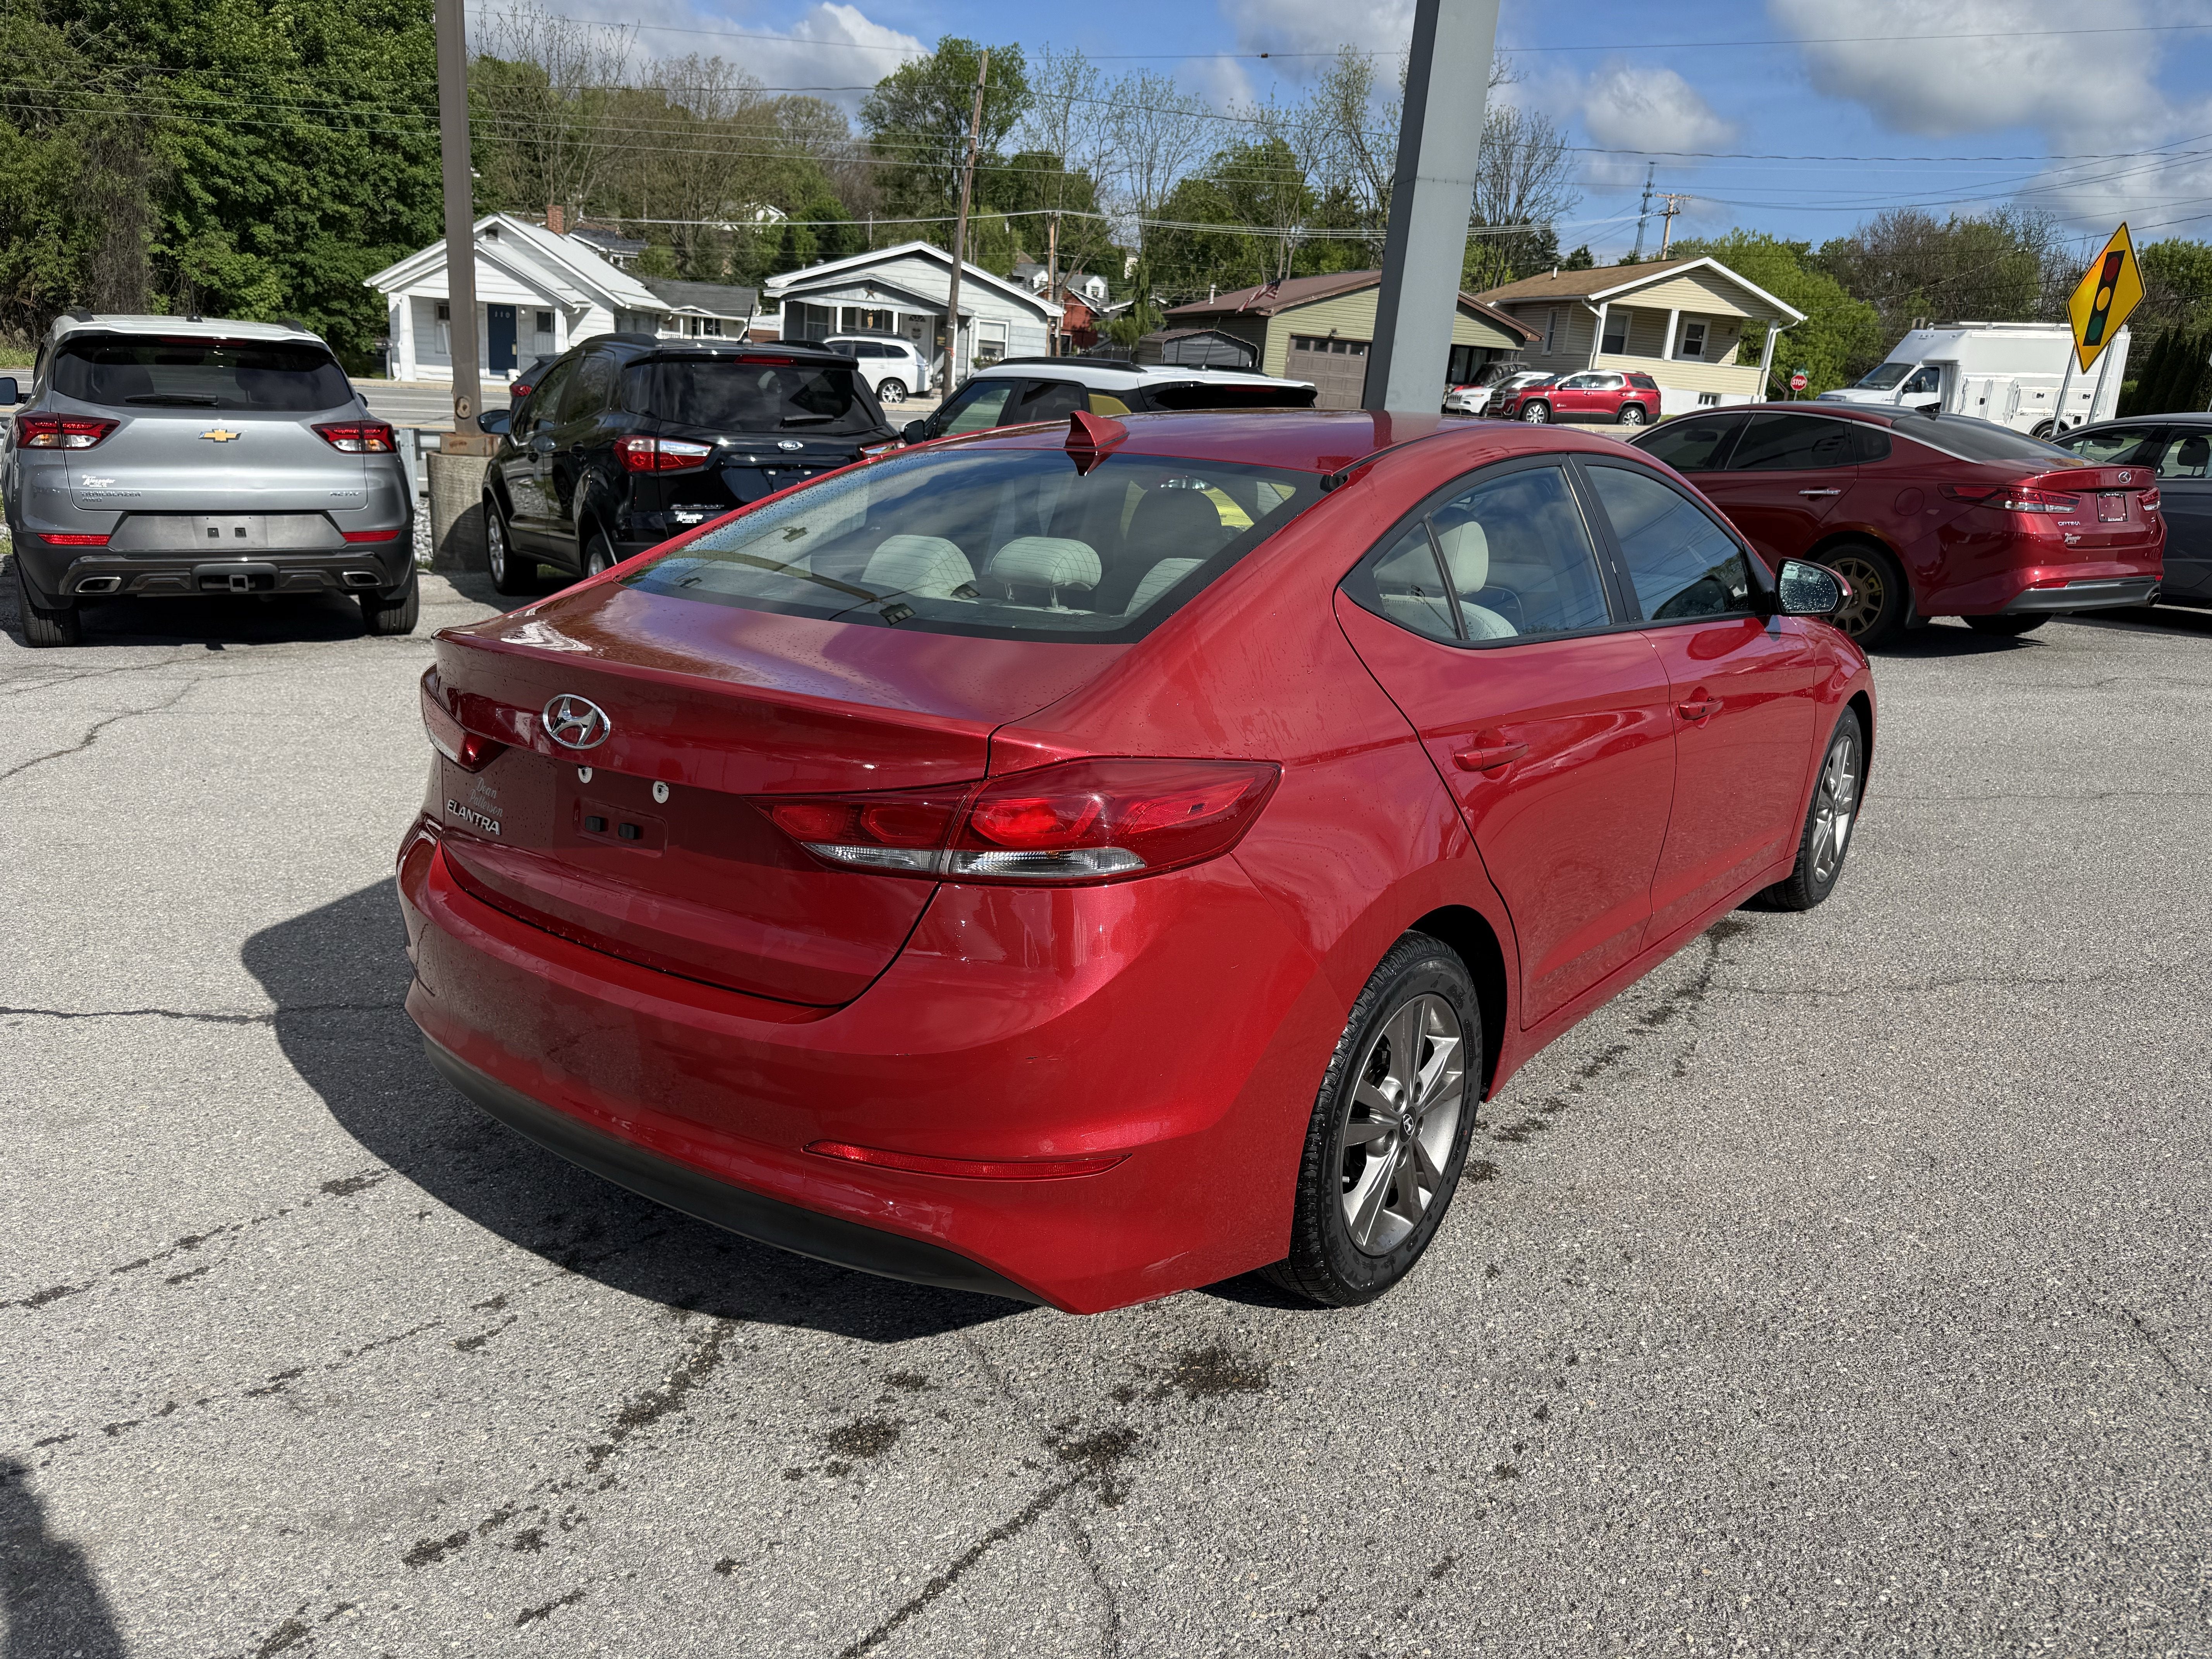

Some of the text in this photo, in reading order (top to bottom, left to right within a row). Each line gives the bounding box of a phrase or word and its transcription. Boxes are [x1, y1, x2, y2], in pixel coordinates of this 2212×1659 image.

[1792, 378, 1805, 386] STOP
[476, 777, 497, 799] Dean
[468, 788, 503, 817] Patterson
[447, 799, 501, 836] ELANTRA
